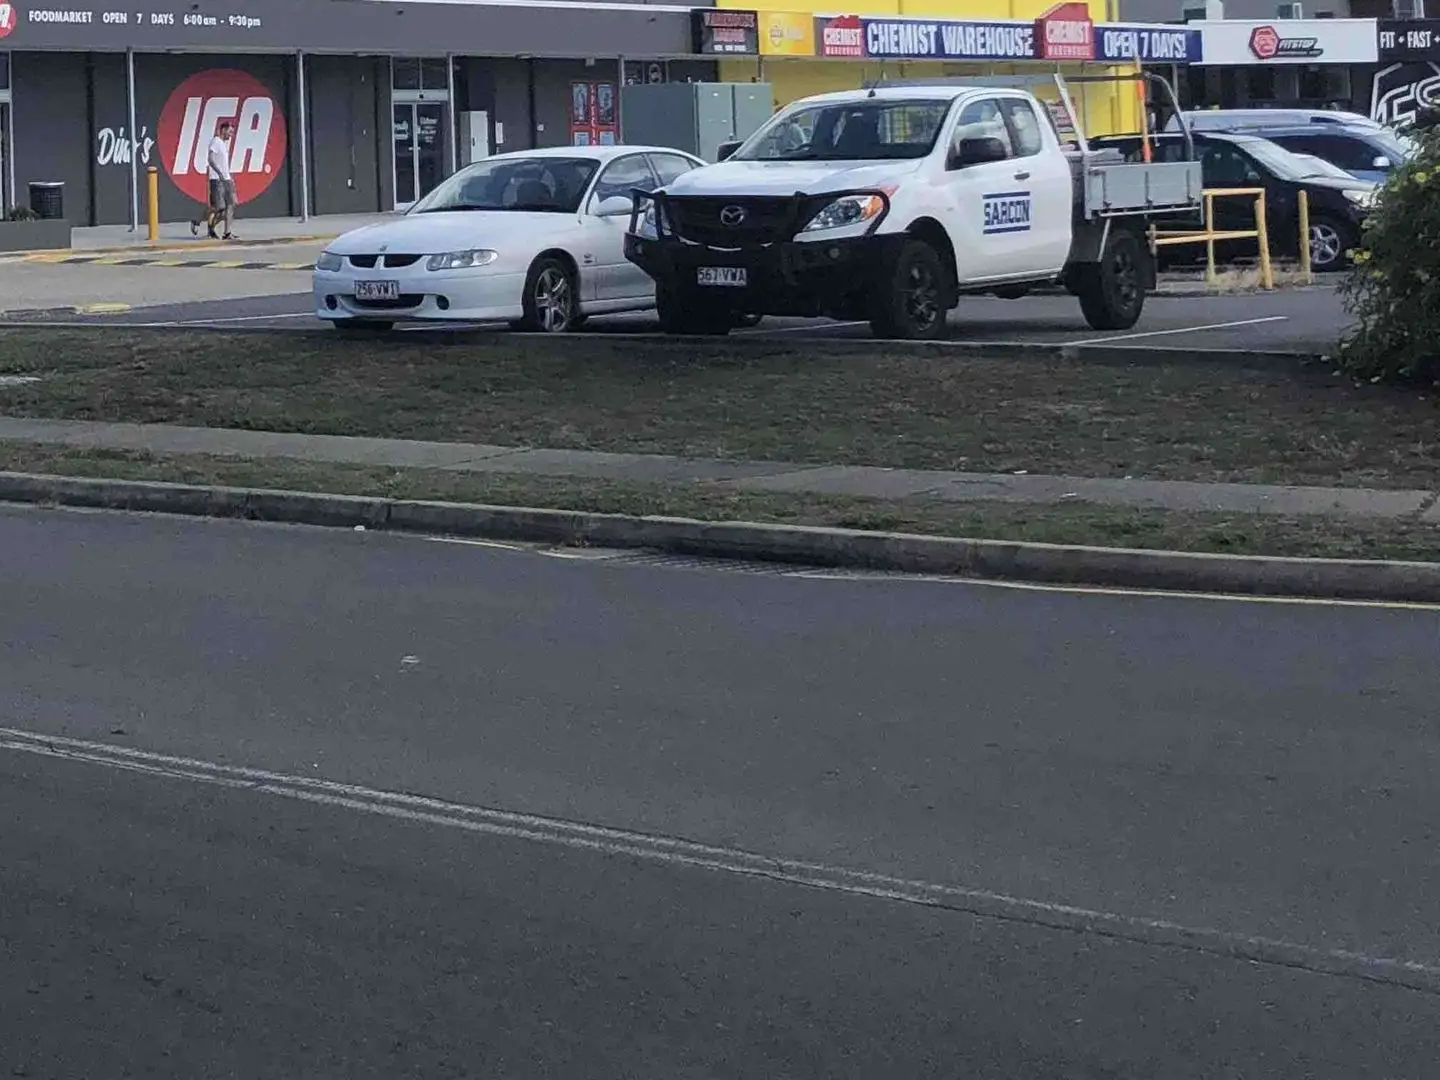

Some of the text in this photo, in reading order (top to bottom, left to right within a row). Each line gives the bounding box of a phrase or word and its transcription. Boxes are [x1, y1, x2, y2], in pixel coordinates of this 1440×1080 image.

[28, 10, 93, 24] FOODMARKET
[102, 11, 128, 24] OPEN
[136, 12, 144, 24] 7
[151, 13, 175, 25] DAYS
[228, 15, 261, 29] 9:30pm
[823, 27, 862, 46] CHEMIST
[867, 23, 1035, 57] CHEMIST WAREHOUSE
[1104, 31, 1186, 59] OPEN 7 DAYS!
[1380, 31, 1396, 49] FIT
[1406, 31, 1431, 48] FAST
[98, 126, 156, 165] Din's
[983, 199, 1030, 226] SARCON
